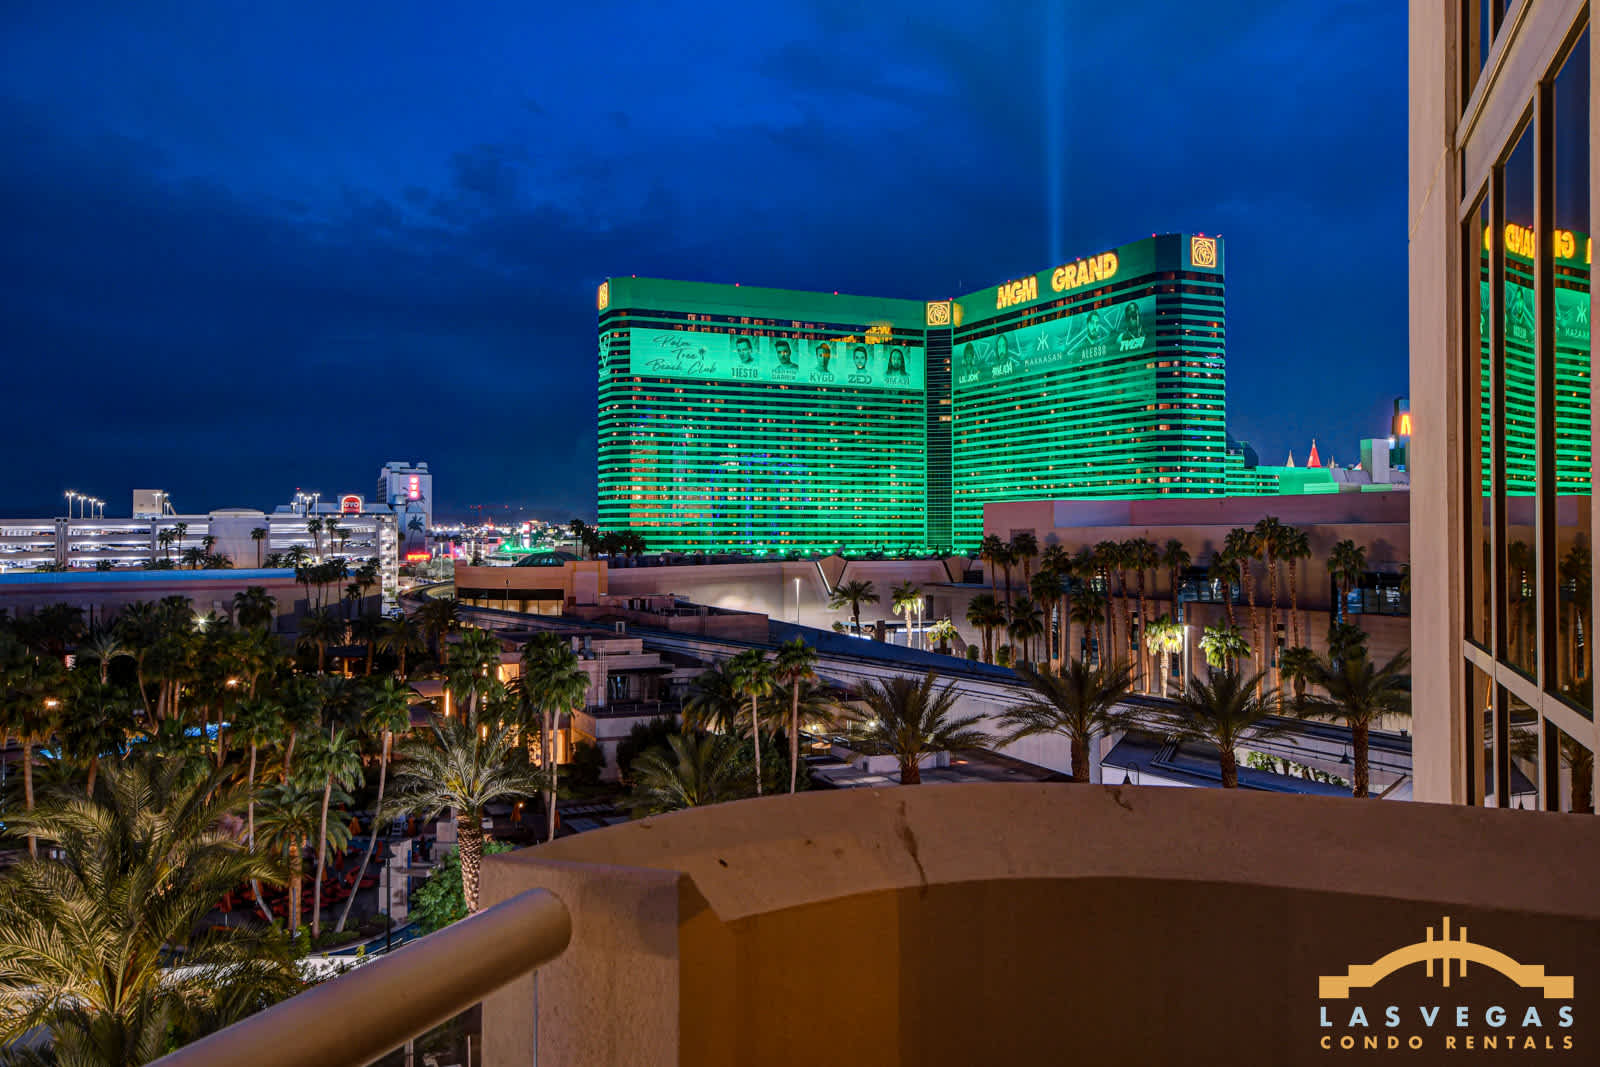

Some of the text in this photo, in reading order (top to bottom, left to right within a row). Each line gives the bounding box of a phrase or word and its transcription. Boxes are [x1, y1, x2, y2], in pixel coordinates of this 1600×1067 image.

[996, 252, 1118, 310] MGM GRAND
[653, 335, 691, 348] Palm
[672, 349, 698, 360] Tree
[1024, 352, 1062, 367] HAKKASAN
[1082, 345, 1107, 360] ALESSO
[645, 359, 717, 375] Beach Club
[809, 372, 834, 383] KYGO
